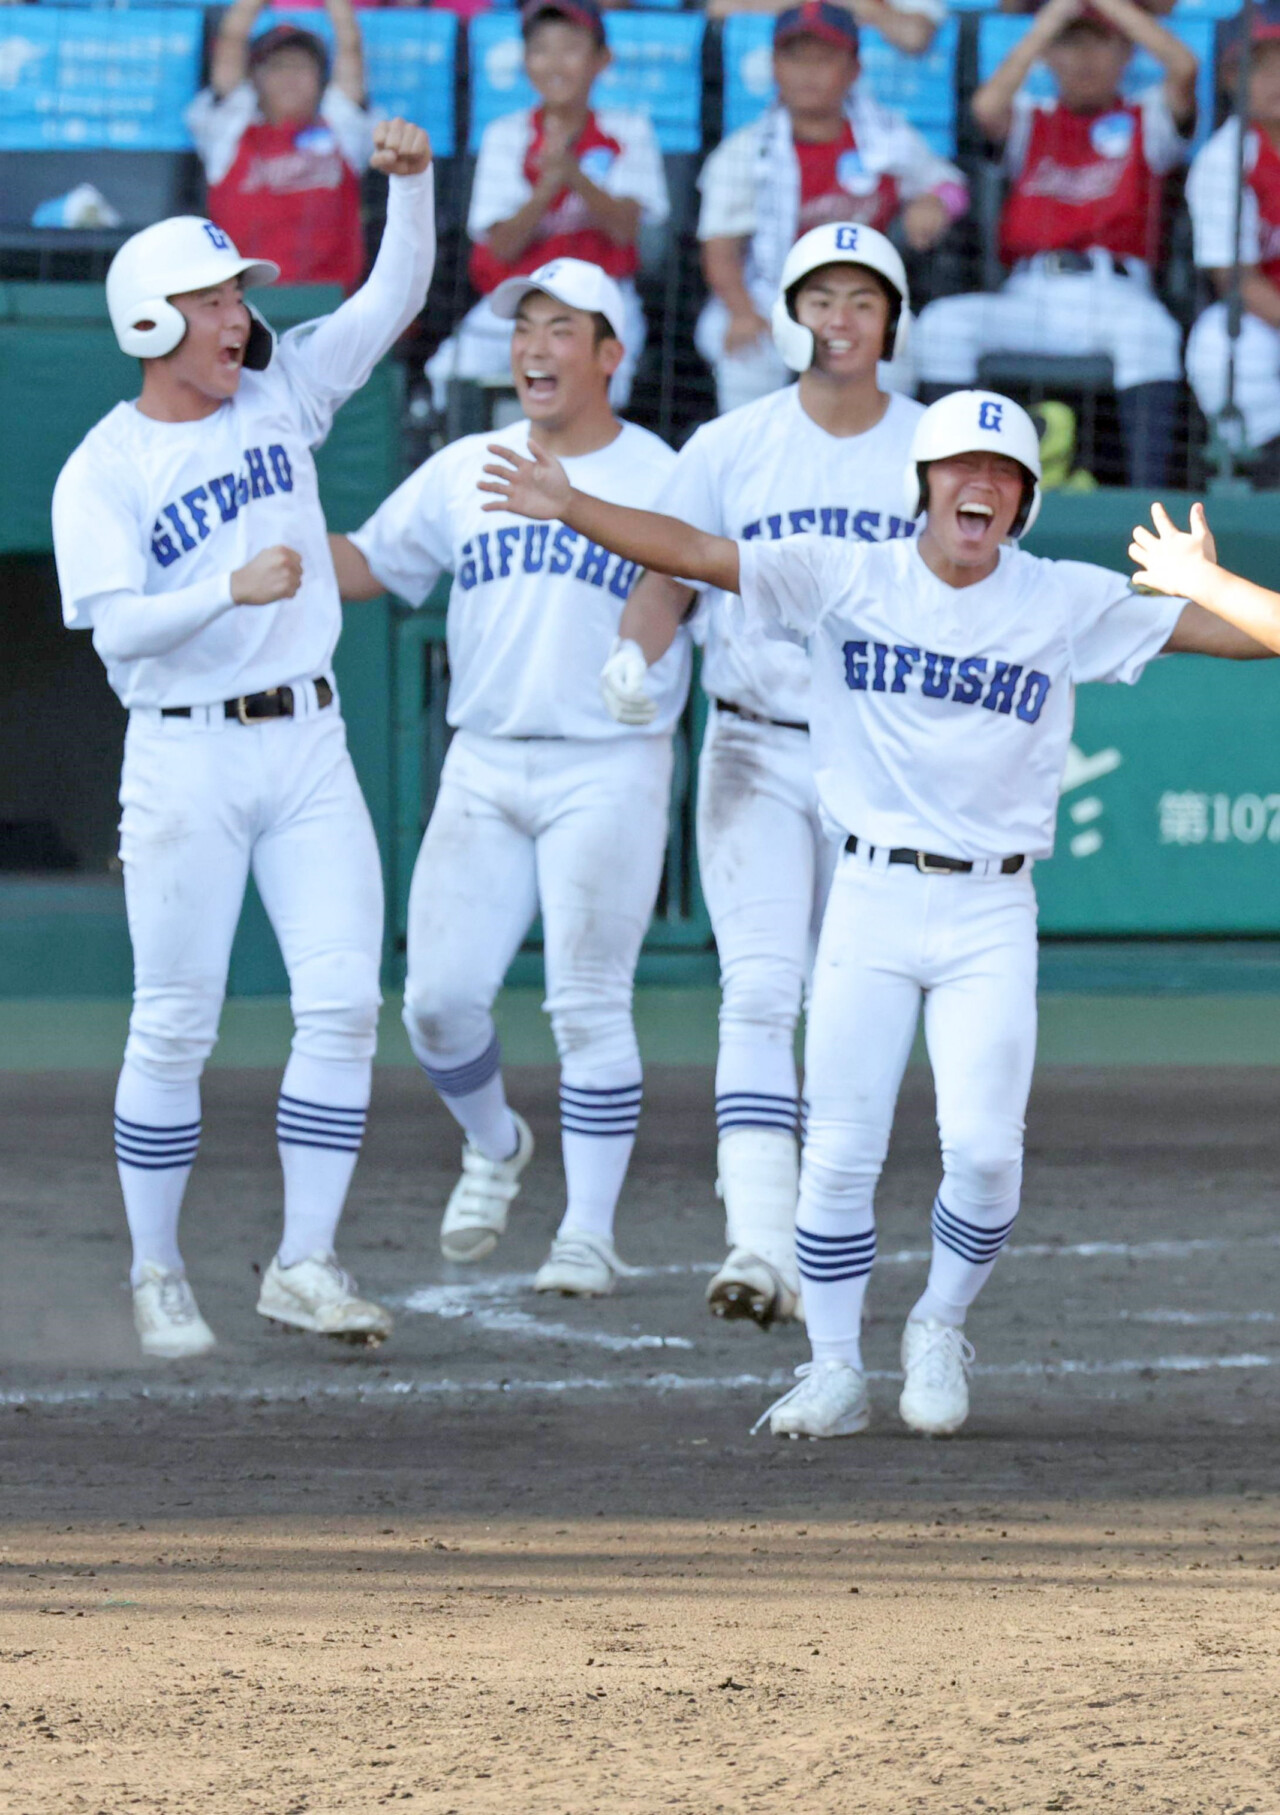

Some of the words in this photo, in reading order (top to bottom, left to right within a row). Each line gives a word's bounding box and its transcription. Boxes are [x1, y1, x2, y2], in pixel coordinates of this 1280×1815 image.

[835, 227, 858, 251] G
[978, 400, 1003, 432] G
[842, 640, 1050, 724] GIFUSHO
